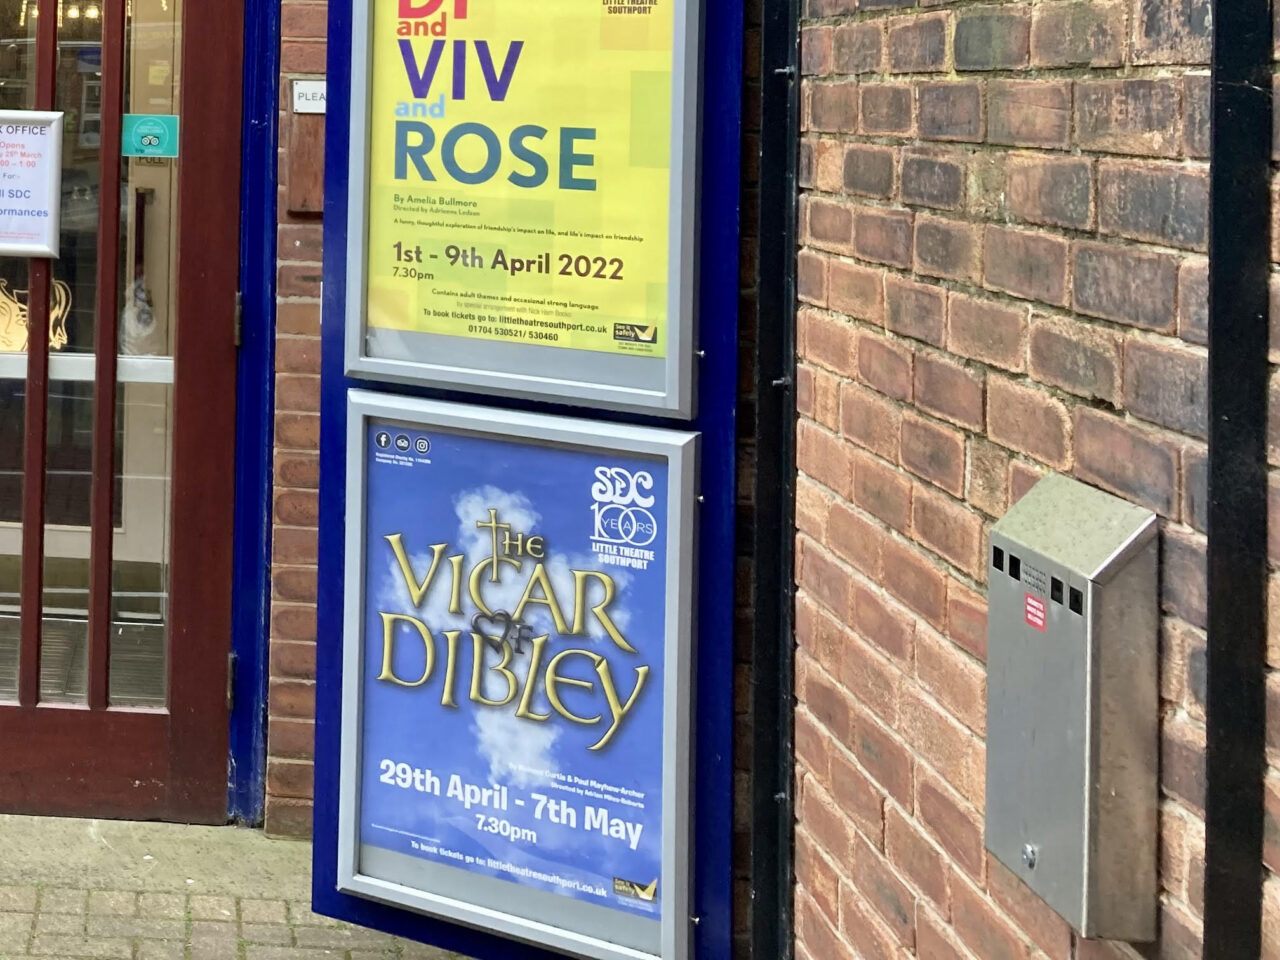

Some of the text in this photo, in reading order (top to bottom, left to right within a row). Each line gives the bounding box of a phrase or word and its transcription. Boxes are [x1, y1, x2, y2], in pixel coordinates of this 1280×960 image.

[608, 6, 652, 15] SOUTHPORT
[396, 12, 447, 37] and
[397, 39, 524, 101] VIV
[394, 94, 445, 119] and
[6, 125, 46, 135] OFFICE
[0, 141, 25, 150] Opens
[394, 120, 597, 191] ROSE
[8, 189, 31, 199] SDC
[394, 194, 478, 208] By Amelia Bullmore
[393, 205, 419, 213] Directed
[483, 224, 516, 233] friendship's
[545, 228, 556, 236] life,
[569, 230, 583, 238] life's
[614, 233, 644, 243] friendship
[393, 242, 422, 263] 1st
[445, 245, 483, 269] 9th
[491, 249, 550, 276] April
[558, 253, 624, 280] 2022
[392, 267, 434, 281] 7.30pm
[431, 288, 458, 297] Contains
[459, 291, 476, 299] adult
[477, 292, 499, 301] themes
[513, 296, 546, 305] occasional
[547, 299, 568, 308] strong
[569, 301, 599, 311] language
[424, 308, 607, 334] To book tickets go to: littletheatresouthport.co.uk
[468, 325, 492, 334] 01704
[528, 330, 558, 341] 530460
[591, 466, 655, 507] SDC
[602, 518, 653, 535] YEARS
[592, 543, 655, 561] LITTLE THEATRE
[598, 554, 648, 570] SOUTHPORT
[384, 533, 638, 653] VICAR
[377, 611, 649, 751] DIBLEY
[574, 776, 588, 786] Paul
[576, 788, 583, 796] by
[380, 759, 440, 796] 29th
[447, 774, 507, 811] April
[531, 793, 576, 828] 7th
[584, 807, 643, 850] May
[475, 814, 537, 843] 7.30pm
[411, 840, 607, 898] To book tickets go to: littletheatresouthport.co.uk
